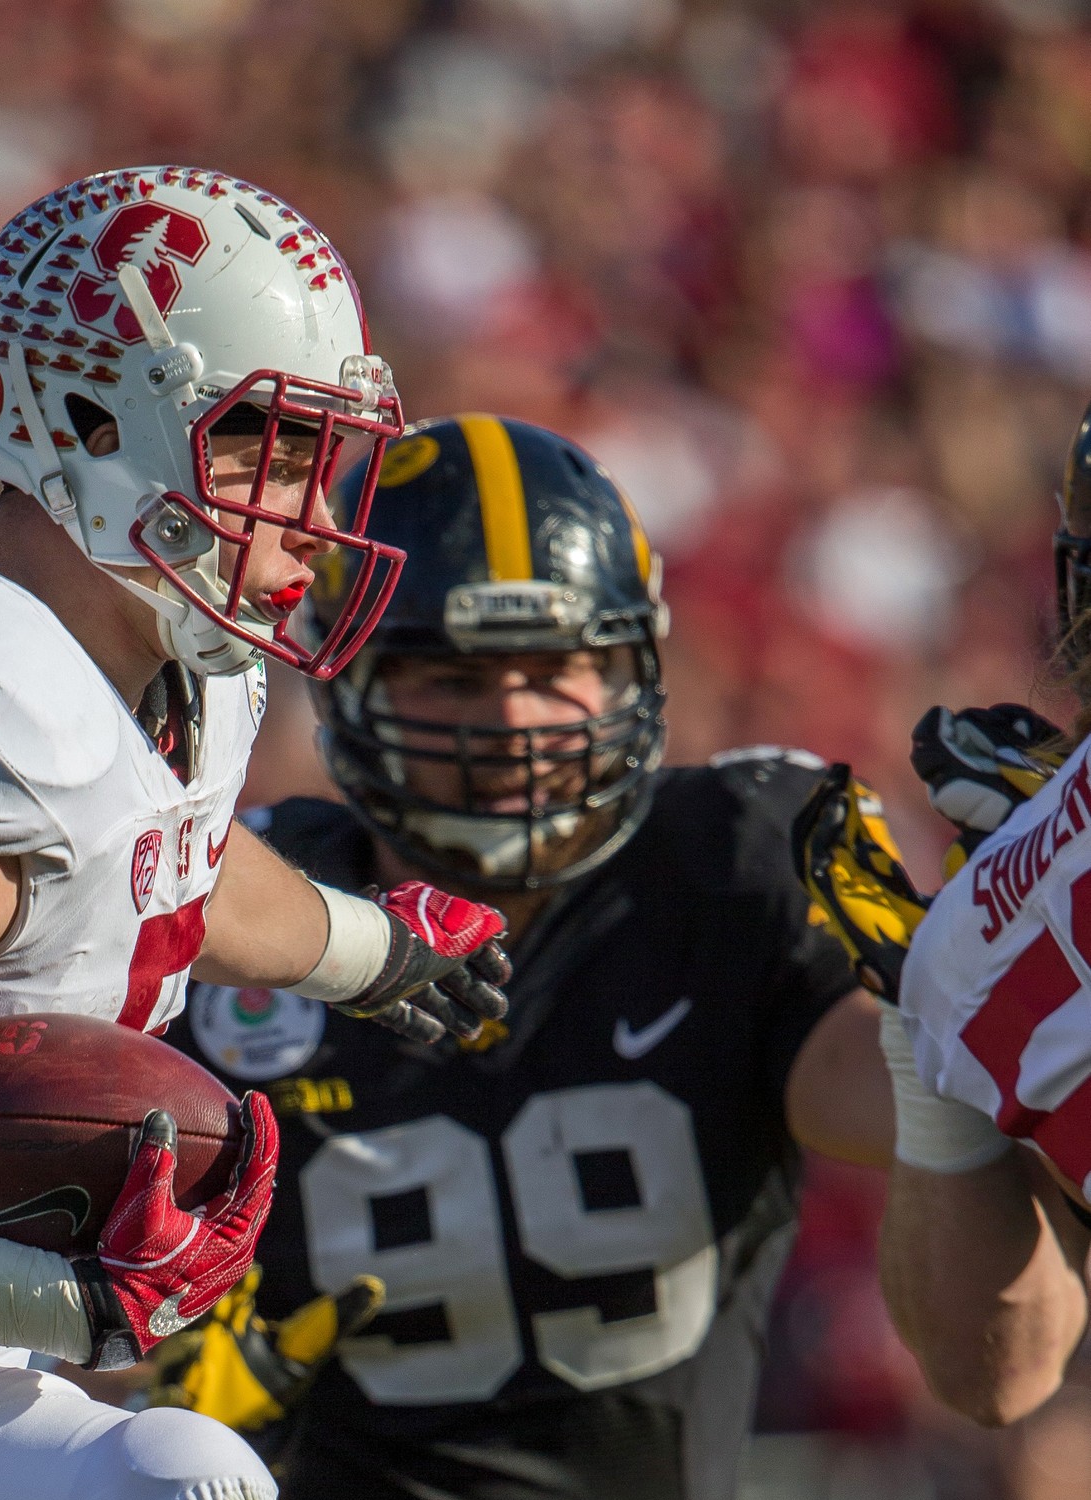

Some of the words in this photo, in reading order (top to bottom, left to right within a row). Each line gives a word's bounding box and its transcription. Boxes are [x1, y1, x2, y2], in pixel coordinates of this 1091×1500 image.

[198, 387, 225, 399] Ridde
[138, 866, 154, 896] 12
[299, 1079, 719, 1407] 99
